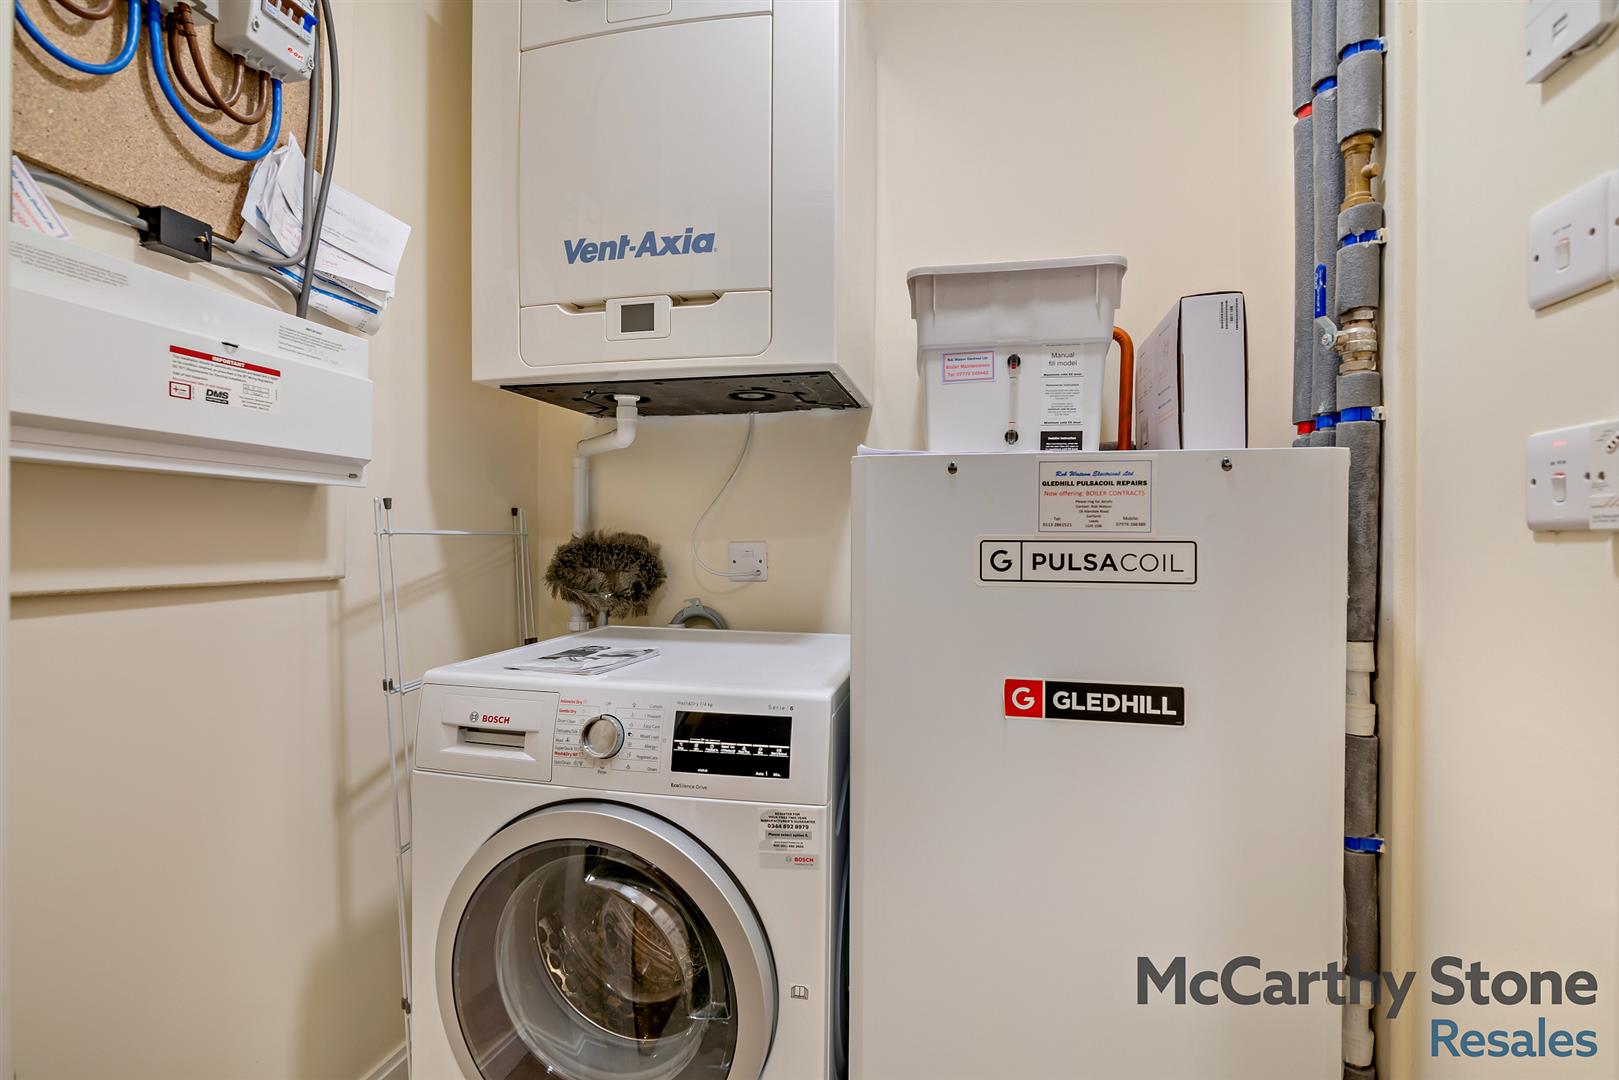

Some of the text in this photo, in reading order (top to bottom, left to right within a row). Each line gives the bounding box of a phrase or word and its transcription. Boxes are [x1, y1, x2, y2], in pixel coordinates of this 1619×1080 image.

[563, 227, 715, 265] Vent-Axia
[212, 356, 245, 368] IMPORTANT
[206, 388, 229, 400] DMS
[990, 550, 1013, 572] G
[1032, 553, 1184, 572] PULSACOIL
[1012, 686, 1036, 710] G
[1052, 691, 1176, 716] GLEDHILL
[482, 714, 510, 724] BOSCH
